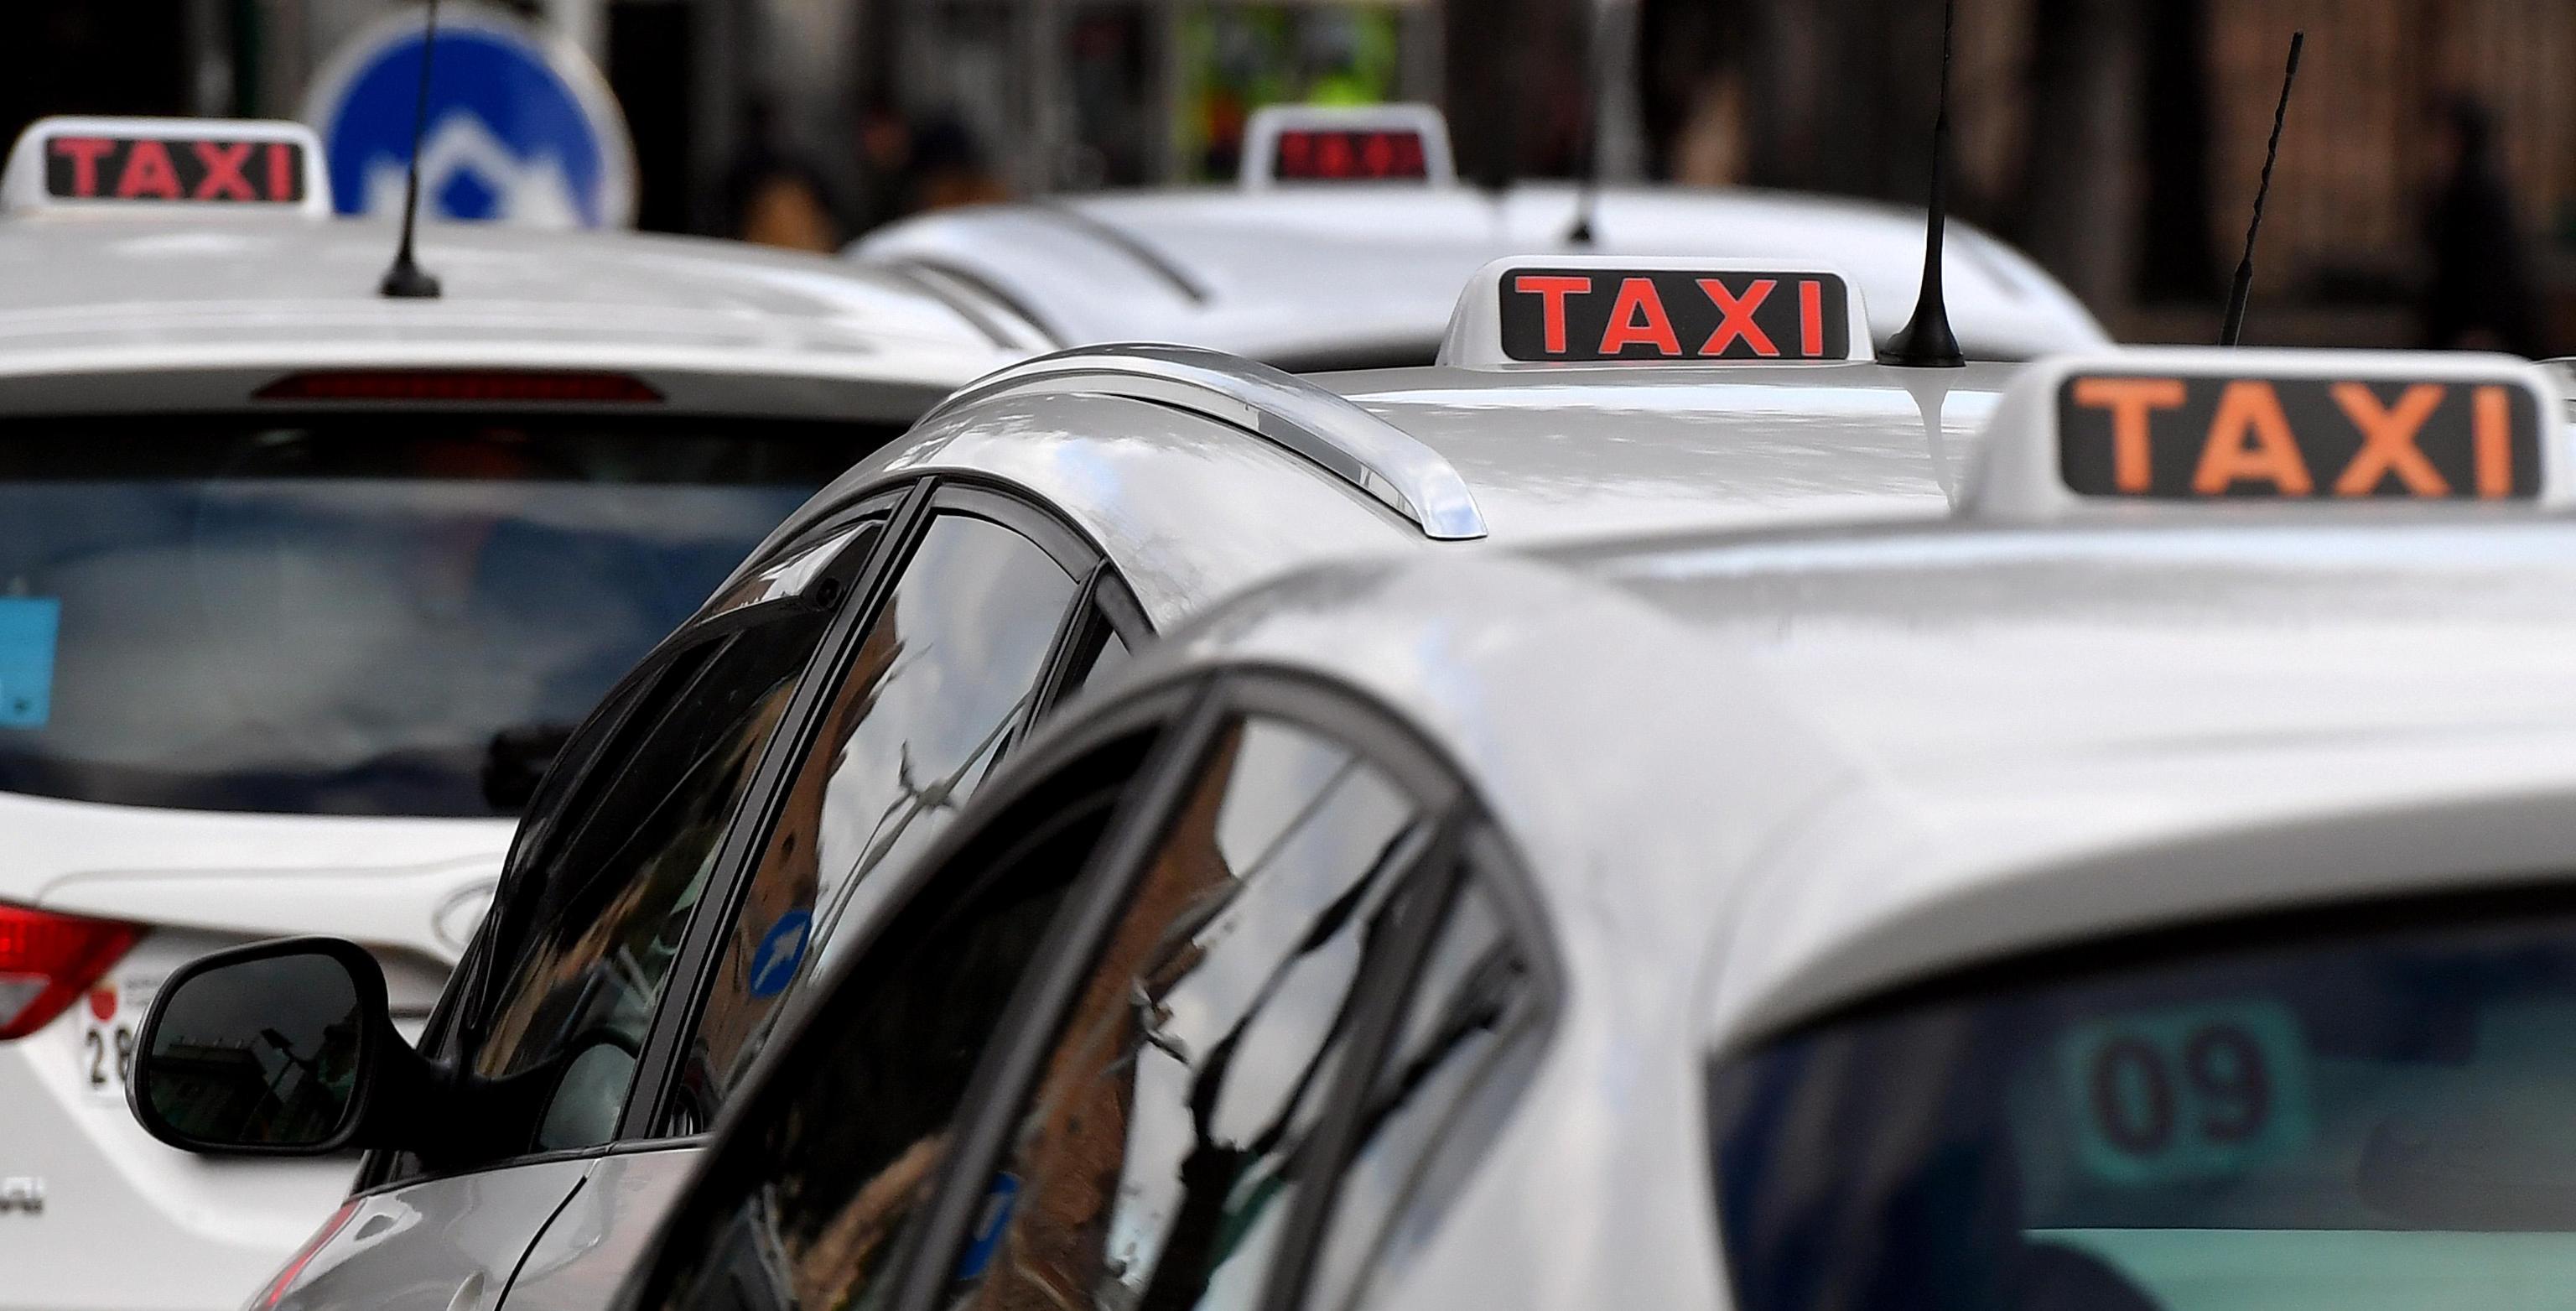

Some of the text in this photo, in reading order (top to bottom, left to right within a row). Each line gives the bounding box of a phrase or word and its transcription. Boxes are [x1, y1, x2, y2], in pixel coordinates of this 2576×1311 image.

[55, 137, 293, 201] TAXI
[1515, 276, 1823, 356] TAXI
[2073, 377, 2514, 498] TAXI
[2091, 1021, 2272, 1158] 09
